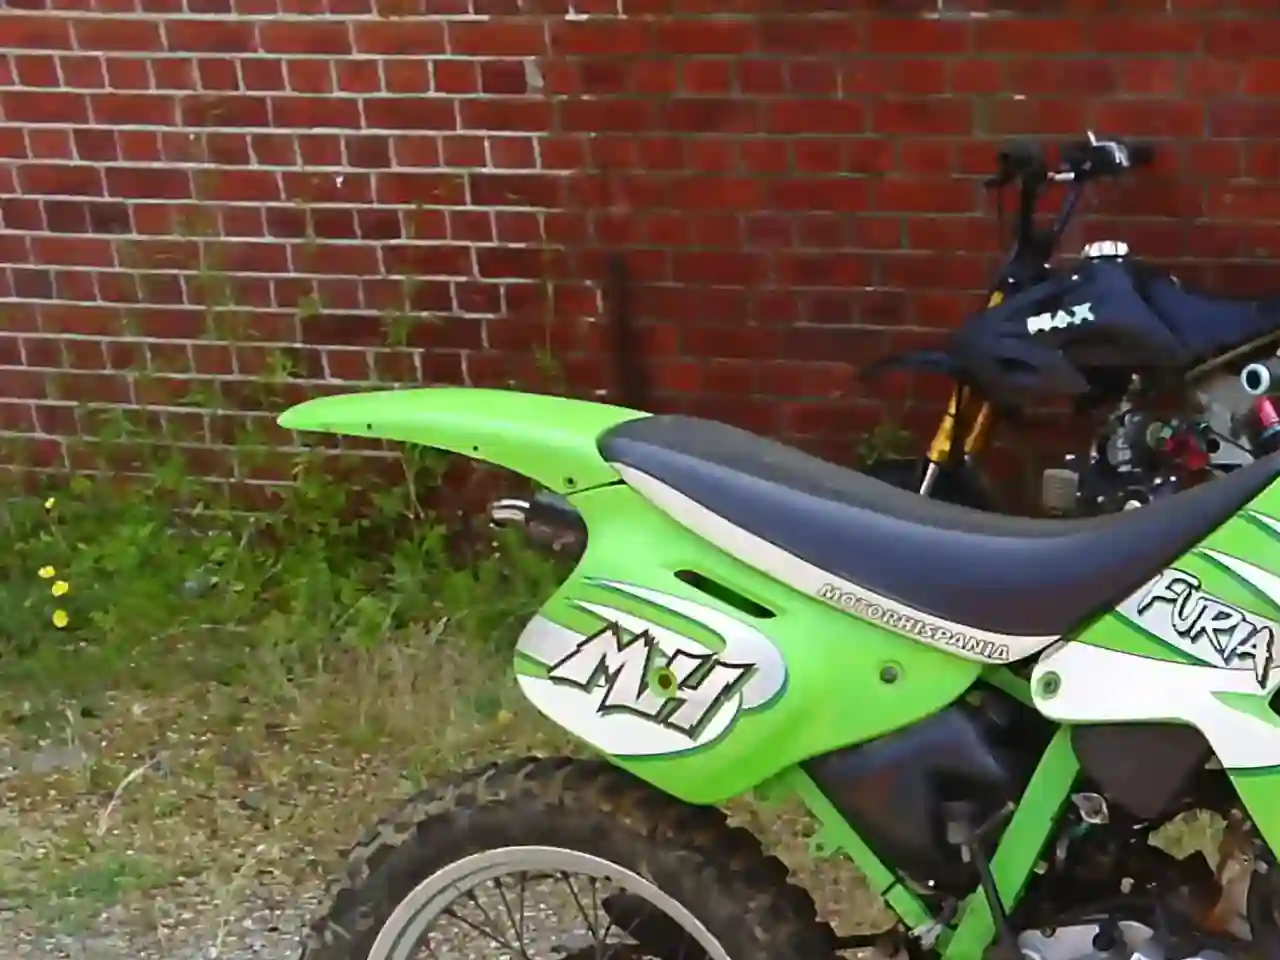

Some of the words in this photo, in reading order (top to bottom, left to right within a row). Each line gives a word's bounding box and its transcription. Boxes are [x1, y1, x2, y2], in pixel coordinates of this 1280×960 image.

[547, 620, 760, 741] MH
[818, 582, 1010, 661] MOTORHISPANIA
[1137, 566, 1275, 690] FURIA
